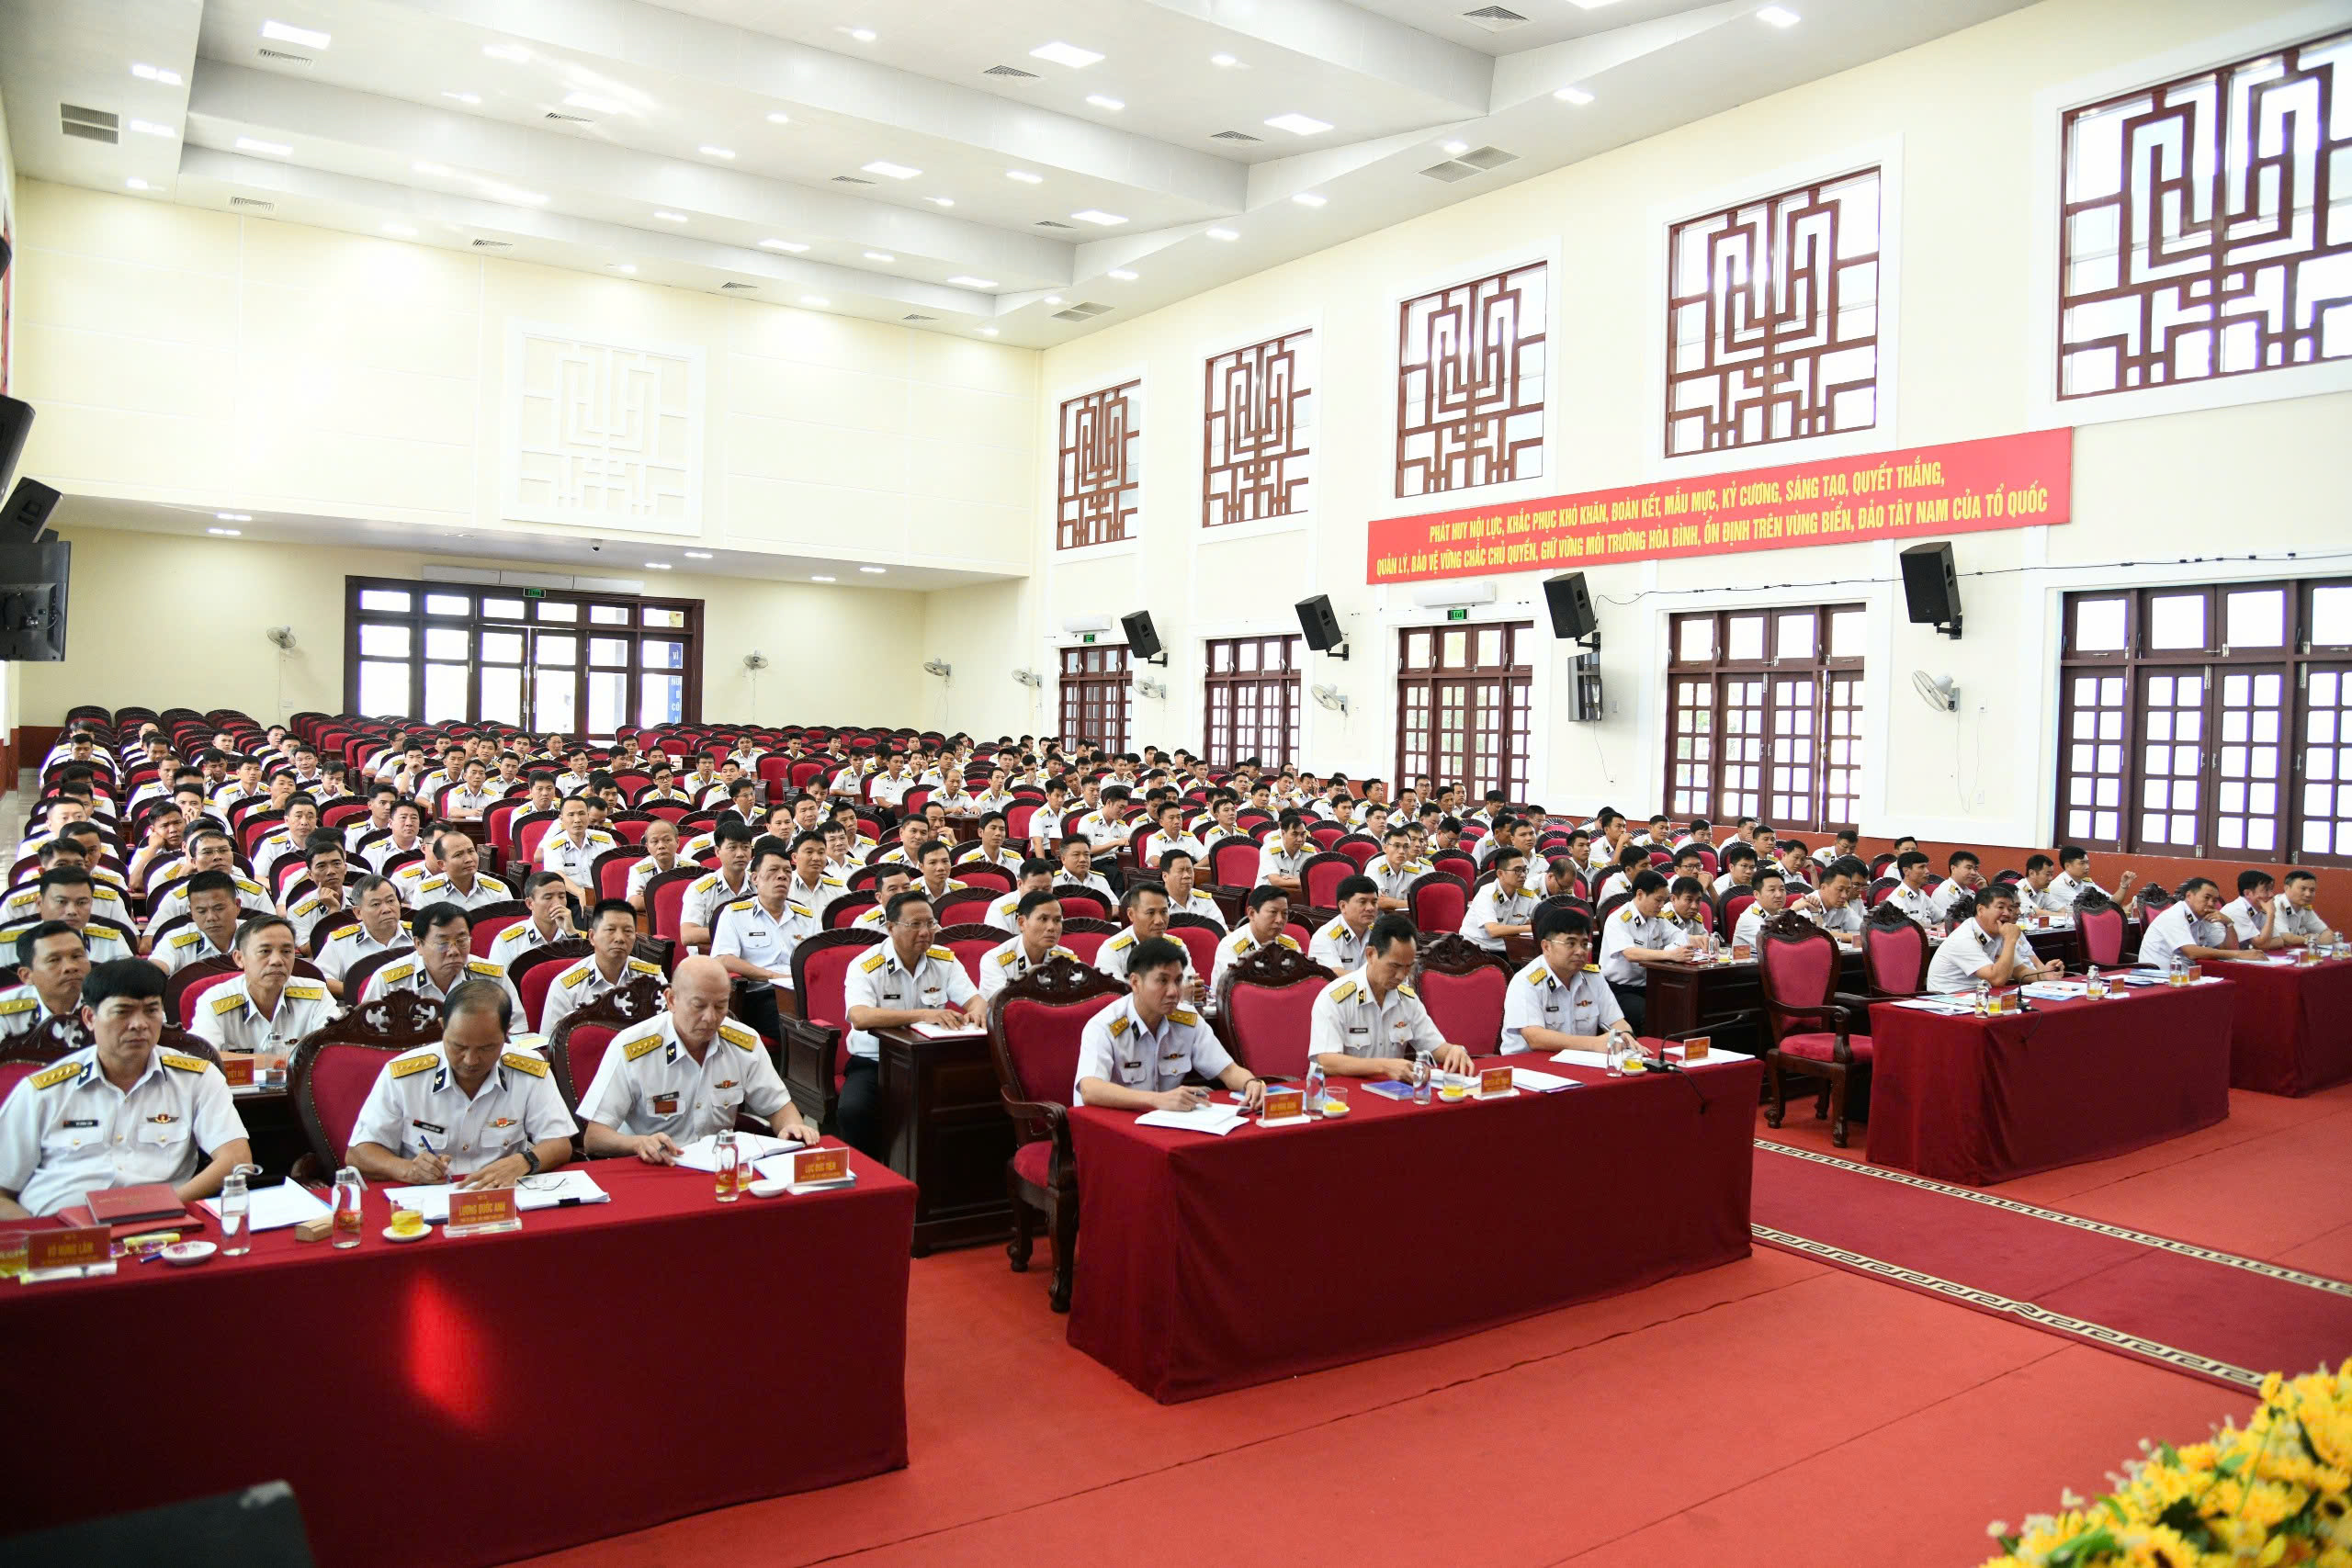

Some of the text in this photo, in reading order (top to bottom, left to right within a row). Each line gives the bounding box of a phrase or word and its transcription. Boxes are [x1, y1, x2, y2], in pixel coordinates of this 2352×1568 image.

[1376, 552, 1396, 577] QUẢN
[1398, 553, 1409, 575] LÝ,
[1411, 548, 1427, 572] BẢO
[1430, 549, 1439, 574] VỆ
[1441, 548, 1462, 570] VỮNG
[1464, 541, 1486, 568] CHẮC
[1488, 540, 1505, 565] CHỦ
[1541, 536, 1558, 559] GIỮ
[1559, 535, 1583, 558] VỮNG
[1586, 532, 1605, 556] MÔI
[1608, 527, 1646, 553] TRƯỜNG
[1649, 525, 1669, 549] HÒA
[1672, 523, 1701, 547] BÌNH,
[1703, 515, 1720, 544] ỔN
[1723, 519, 1750, 547] ĐỊNH
[1753, 513, 1782, 539] TRÊN
[1786, 510, 1818, 536] VÙNG
[1821, 501, 1855, 533] BIỂN,
[1858, 499, 1884, 529] ĐẢO
[1888, 499, 1913, 526] TÂY
[1916, 499, 1949, 524] NAM
[1953, 488, 1982, 520] CỦA
[1985, 483, 2004, 517] TỔ
[2007, 479, 2048, 518] QUỐC
[1430, 456, 1945, 543] PHÁT HUY NỘI LỰC, KHẮC PHỤC KHÓ KHĂN, ĐOÀN KẾT, MẪU MỰC, KỶ CƯƠNG, SÁNG TẠO, QUYẾT THẮNG,
